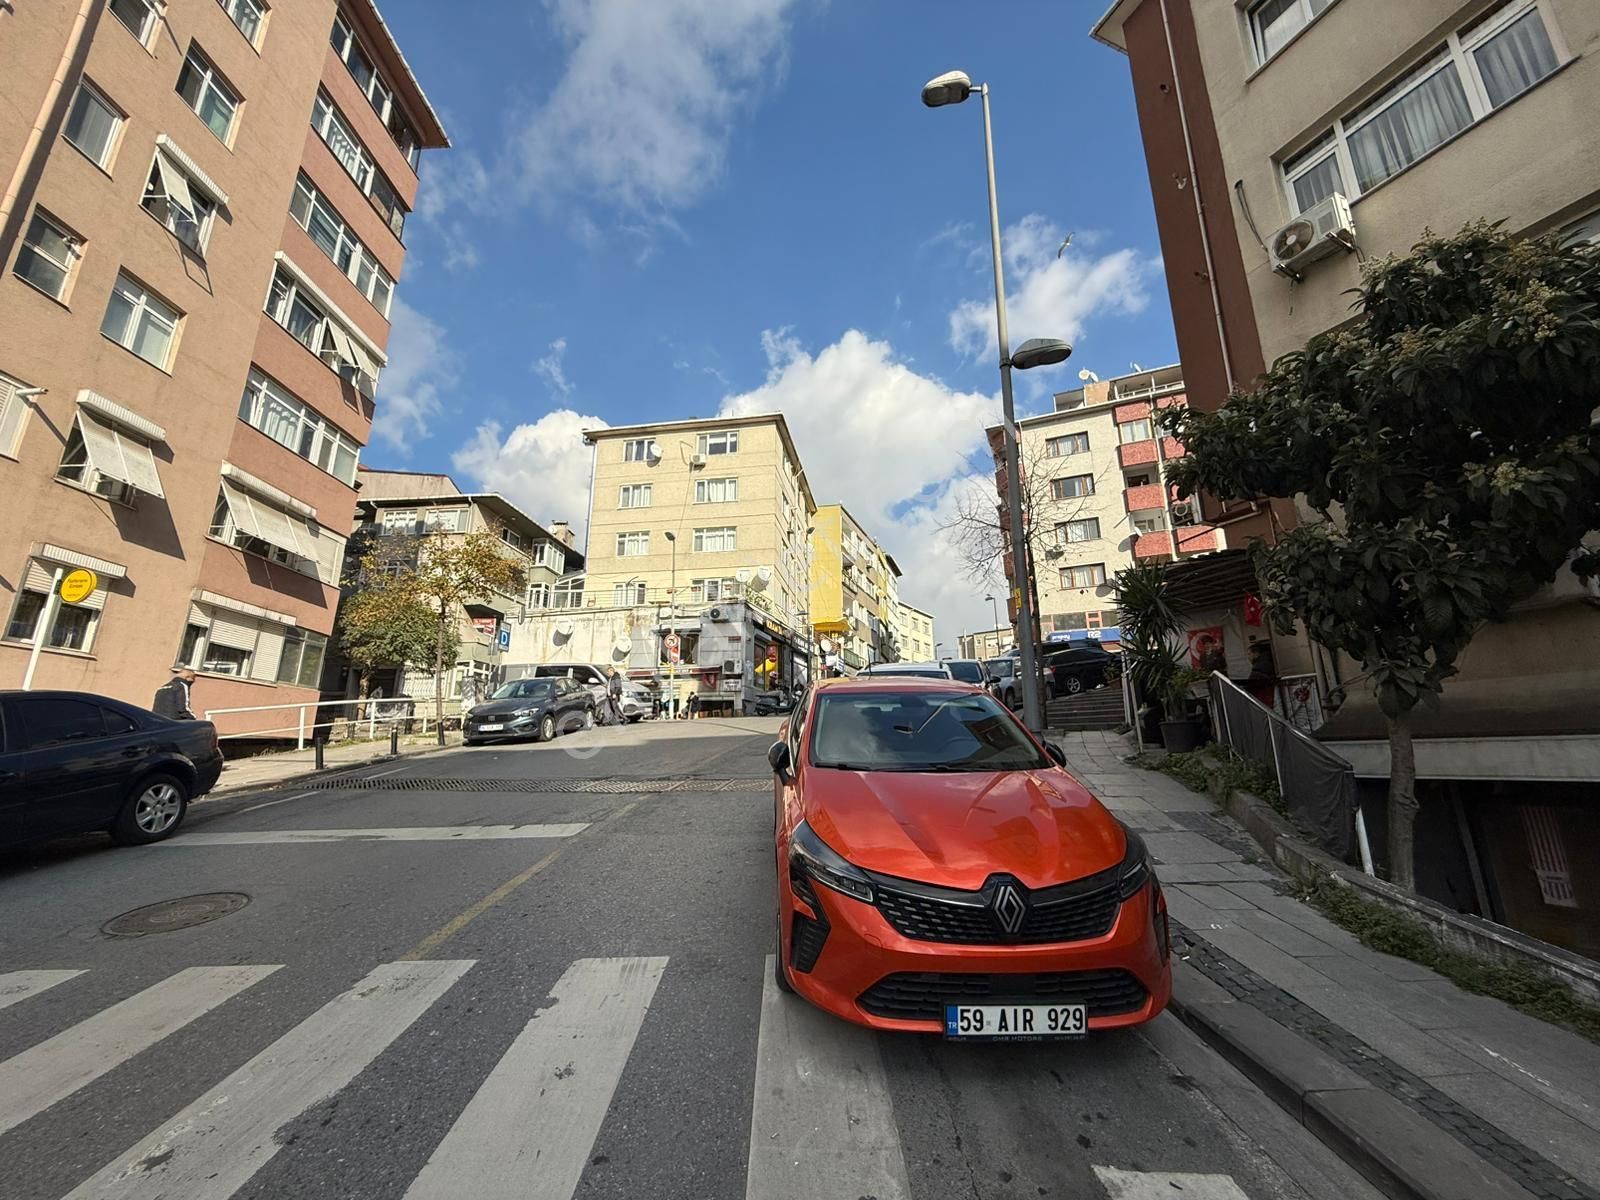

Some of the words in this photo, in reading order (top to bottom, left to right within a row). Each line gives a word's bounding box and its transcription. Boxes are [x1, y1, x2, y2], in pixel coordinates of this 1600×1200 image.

[501, 632, 508, 645] D
[960, 1008, 984, 1032] 59
[998, 1008, 1034, 1032] AIR
[1048, 1007, 1084, 1031] 929
